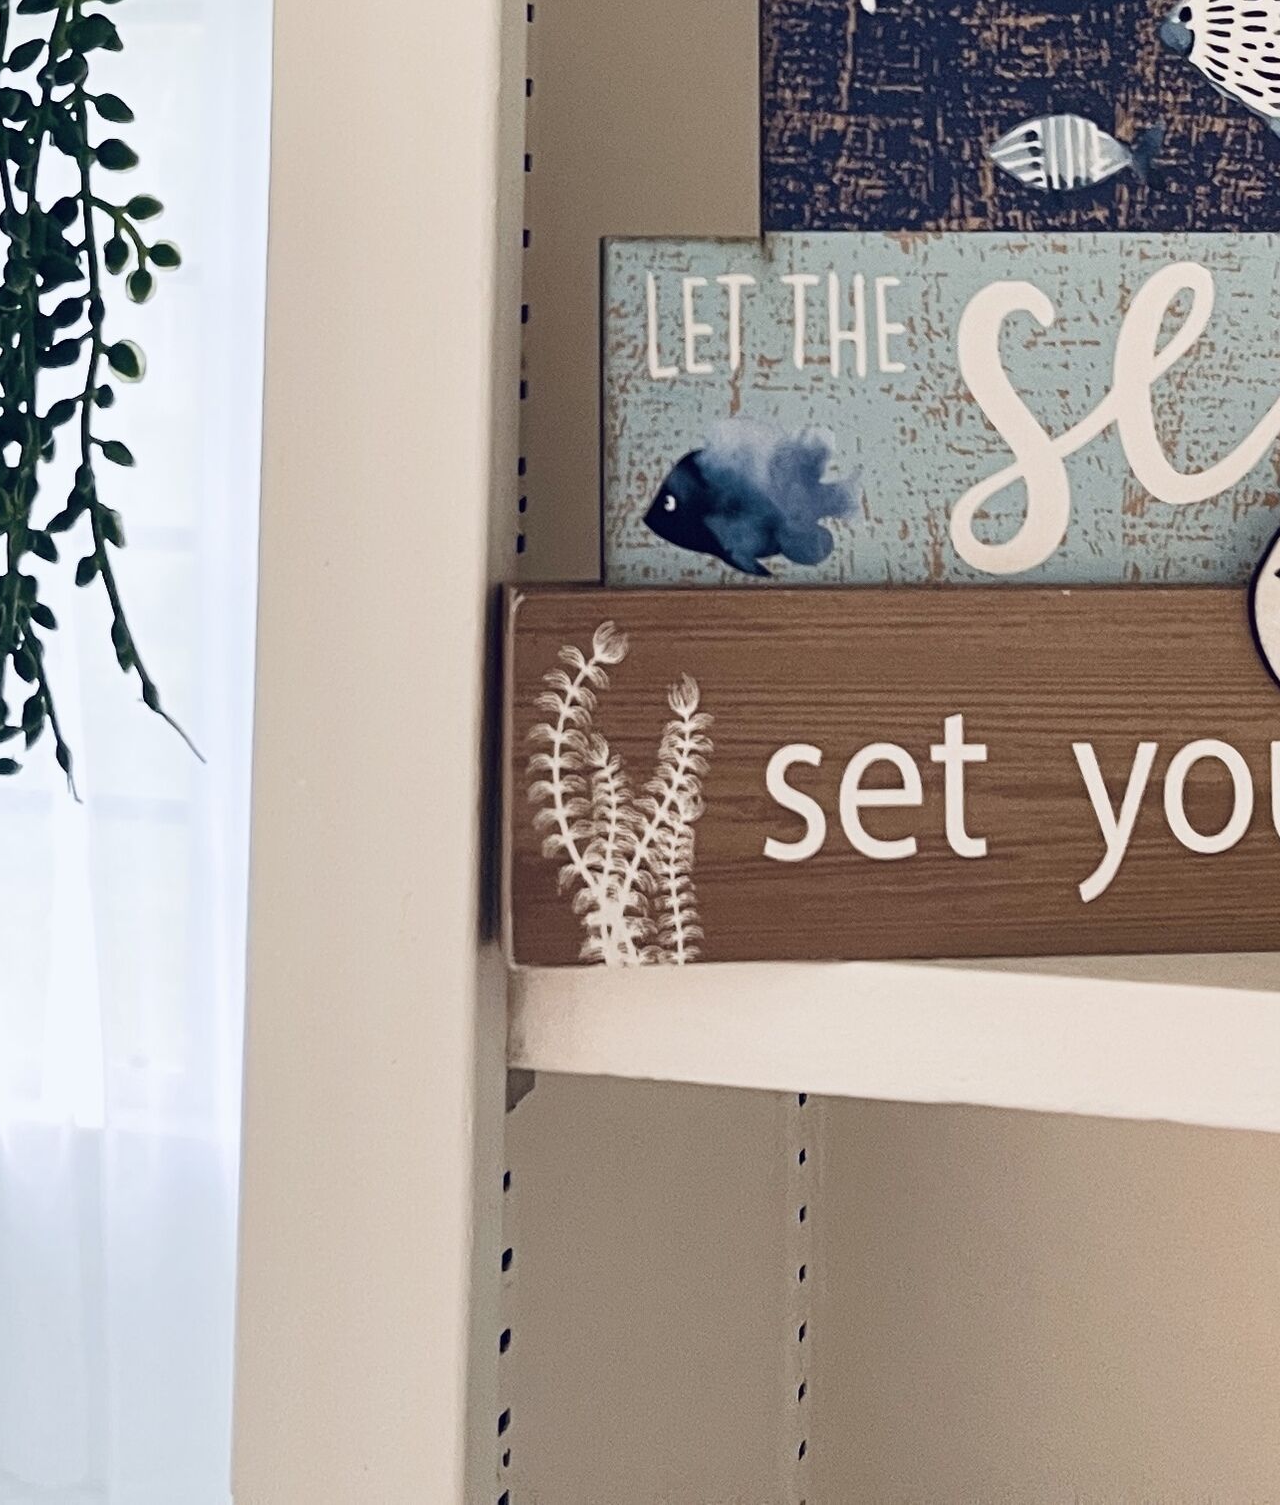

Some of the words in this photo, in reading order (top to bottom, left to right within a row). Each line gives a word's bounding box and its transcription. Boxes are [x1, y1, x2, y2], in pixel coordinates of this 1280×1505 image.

[646, 273, 756, 379] LET
[781, 273, 907, 379] THE
[762, 714, 988, 861] set
